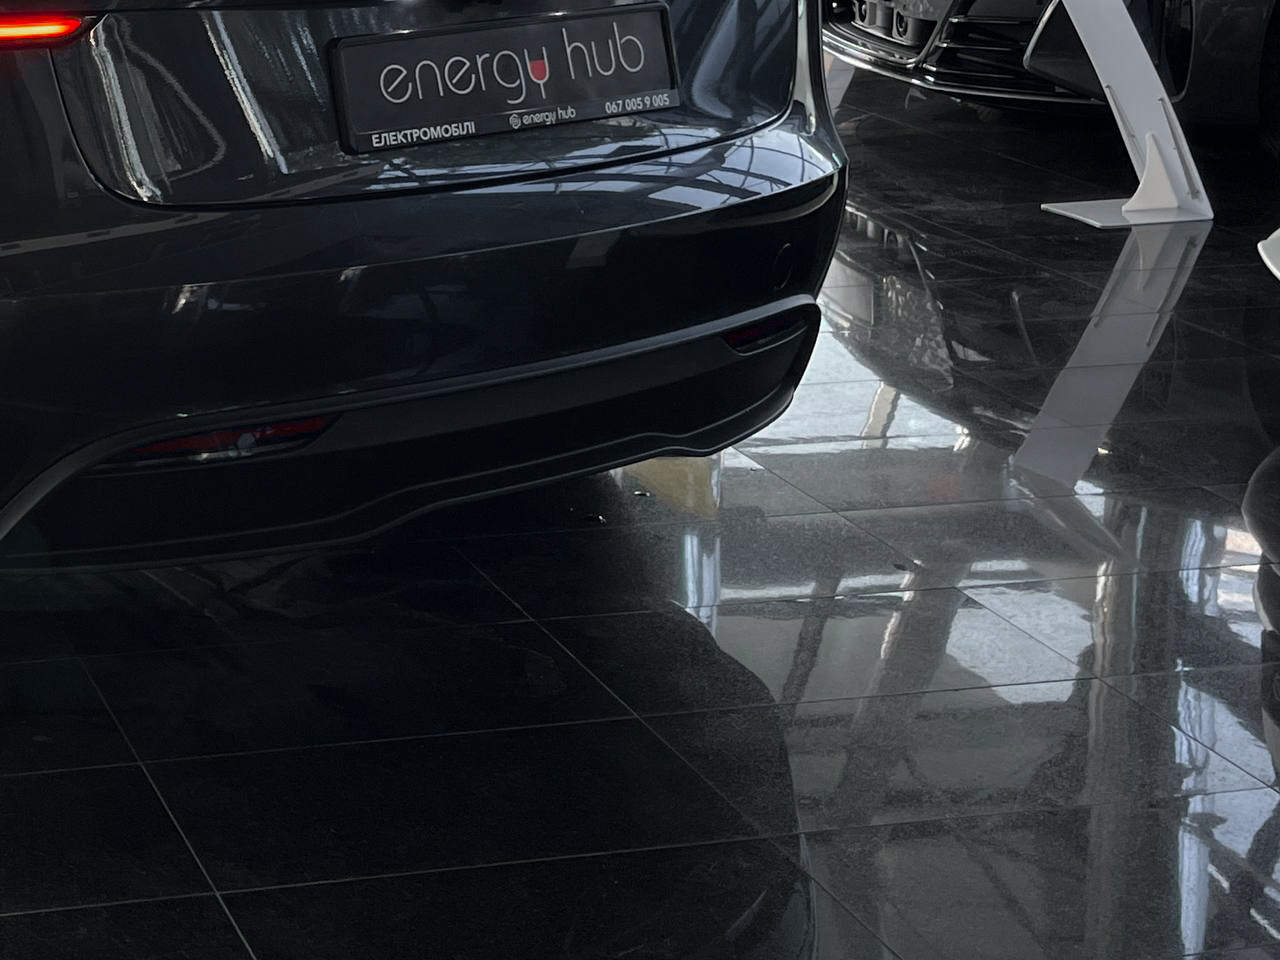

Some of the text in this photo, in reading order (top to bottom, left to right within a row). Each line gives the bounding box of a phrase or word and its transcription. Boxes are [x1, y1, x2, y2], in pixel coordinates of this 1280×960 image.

[380, 22, 645, 105] energy hub
[605, 93, 670, 113] 067 005 9 005
[522, 106, 576, 125] energy hub
[372, 121, 476, 147] ЕЛЕКТРОМОБІЛІ
